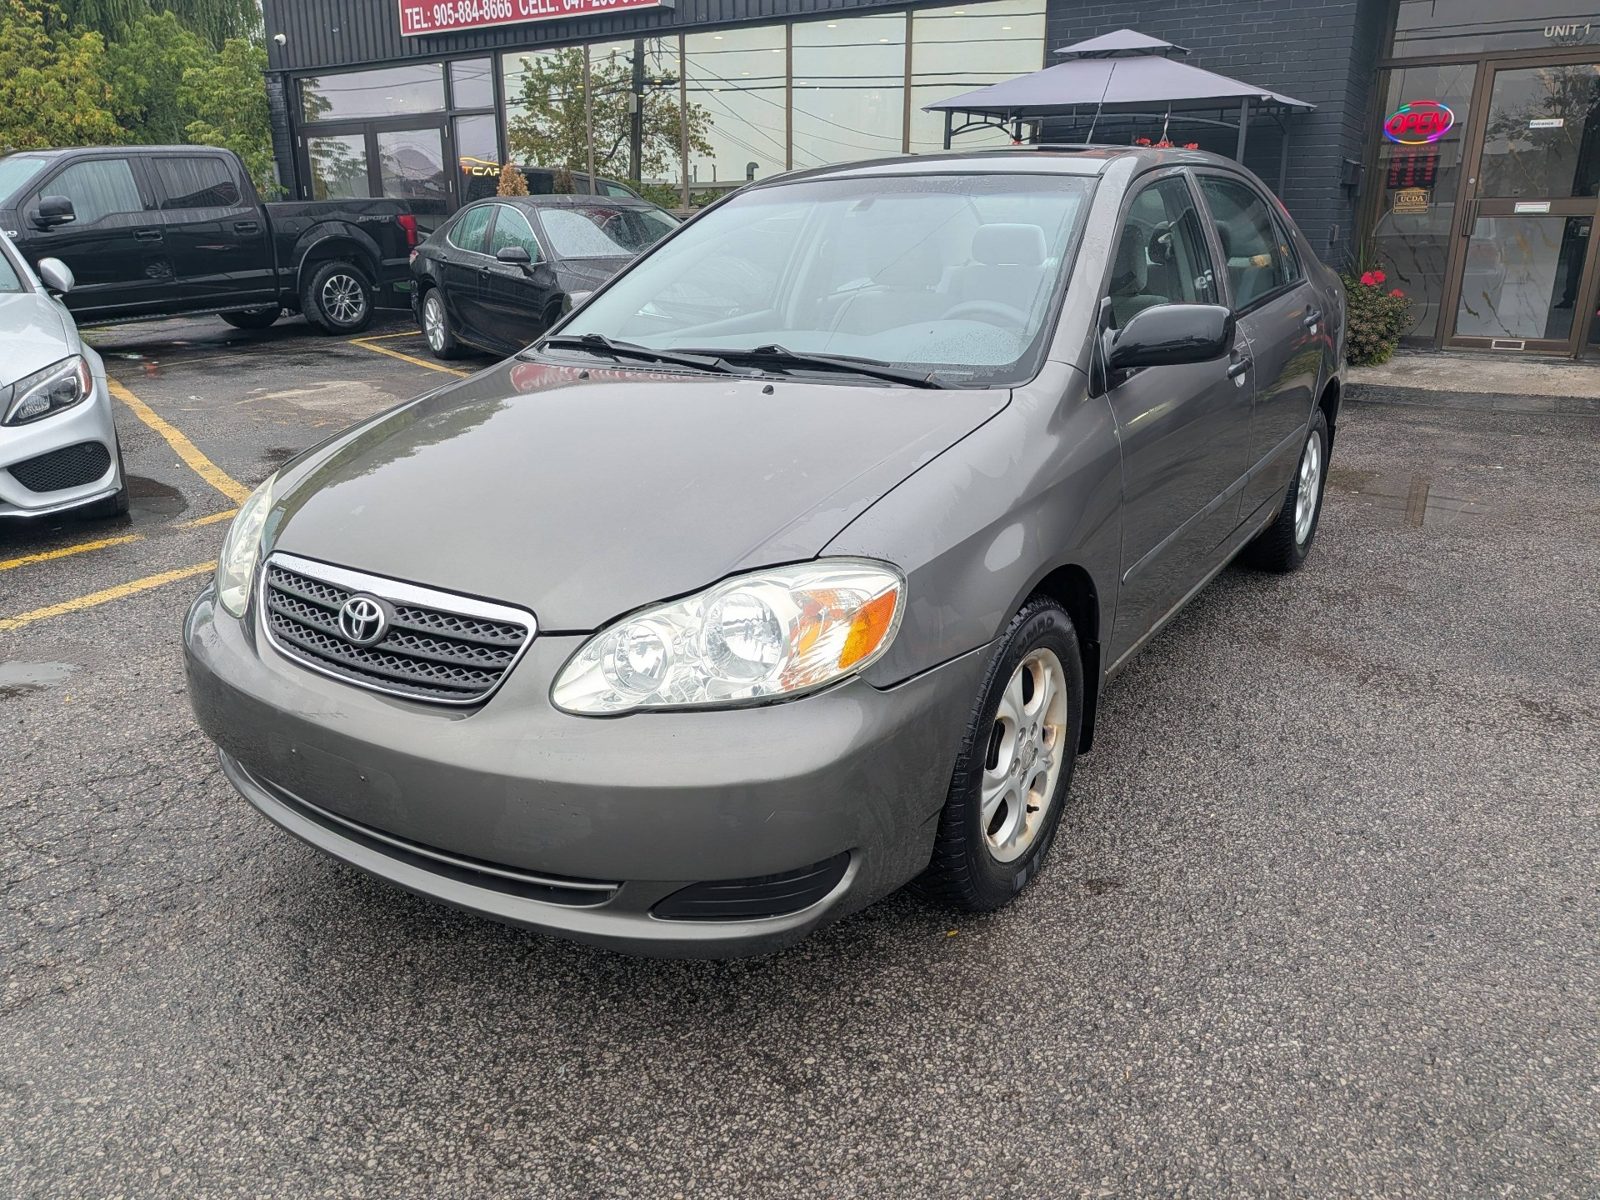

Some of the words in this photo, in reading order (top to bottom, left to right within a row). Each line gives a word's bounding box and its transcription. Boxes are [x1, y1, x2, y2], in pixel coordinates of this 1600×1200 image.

[405, 7, 432, 30] TEL:
[433, 0, 512, 27] 905-884-8666
[1544, 24, 1580, 37] UNIT
[1584, 23, 1591, 35] 1
[1388, 111, 1449, 135] OPEN
[1400, 194, 1424, 203] UCDA
